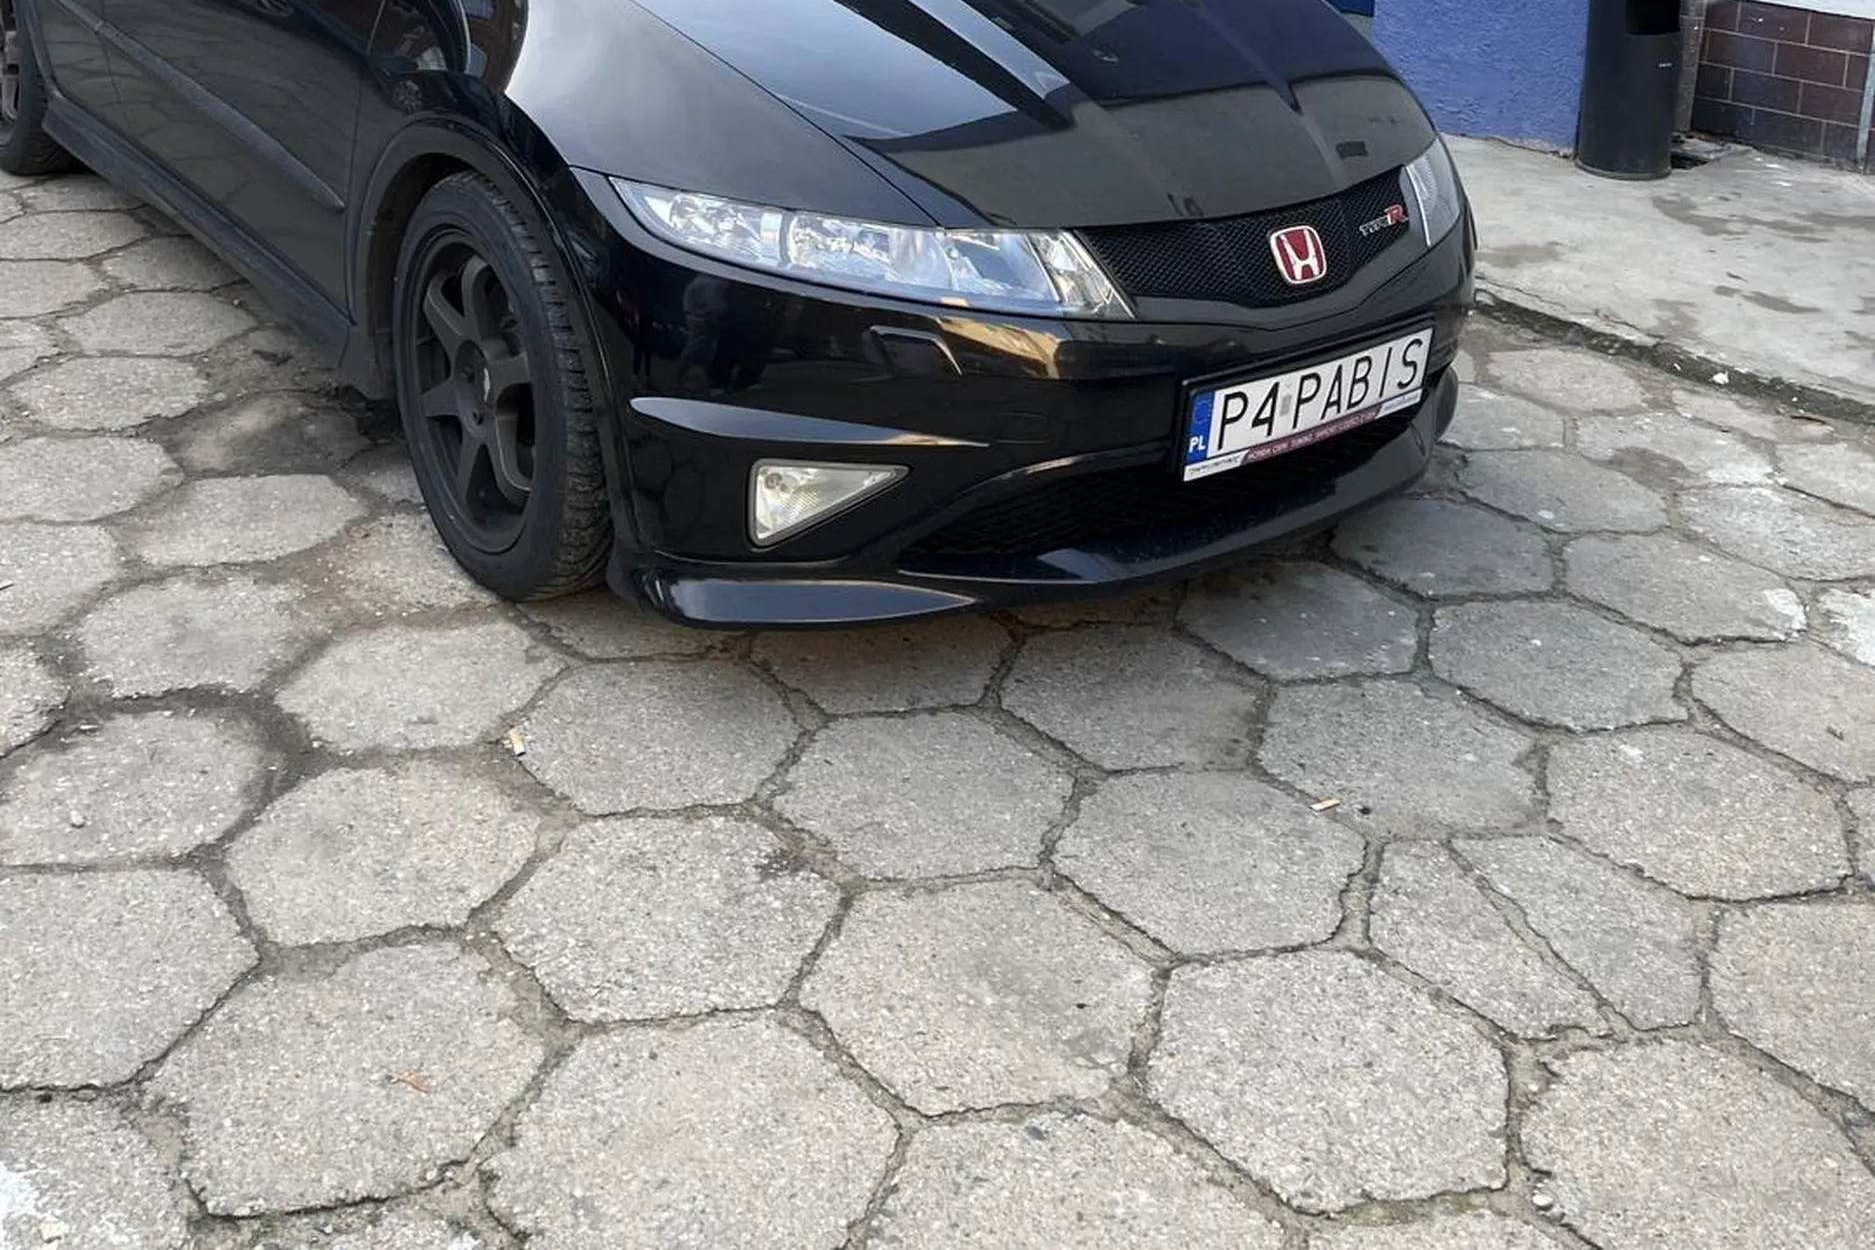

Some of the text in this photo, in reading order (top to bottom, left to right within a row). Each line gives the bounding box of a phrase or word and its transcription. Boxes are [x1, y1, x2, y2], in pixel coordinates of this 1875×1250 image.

[1217, 382, 1280, 451] P4
[1292, 337, 1423, 430] PABIS
[1188, 436, 1207, 453] PL
